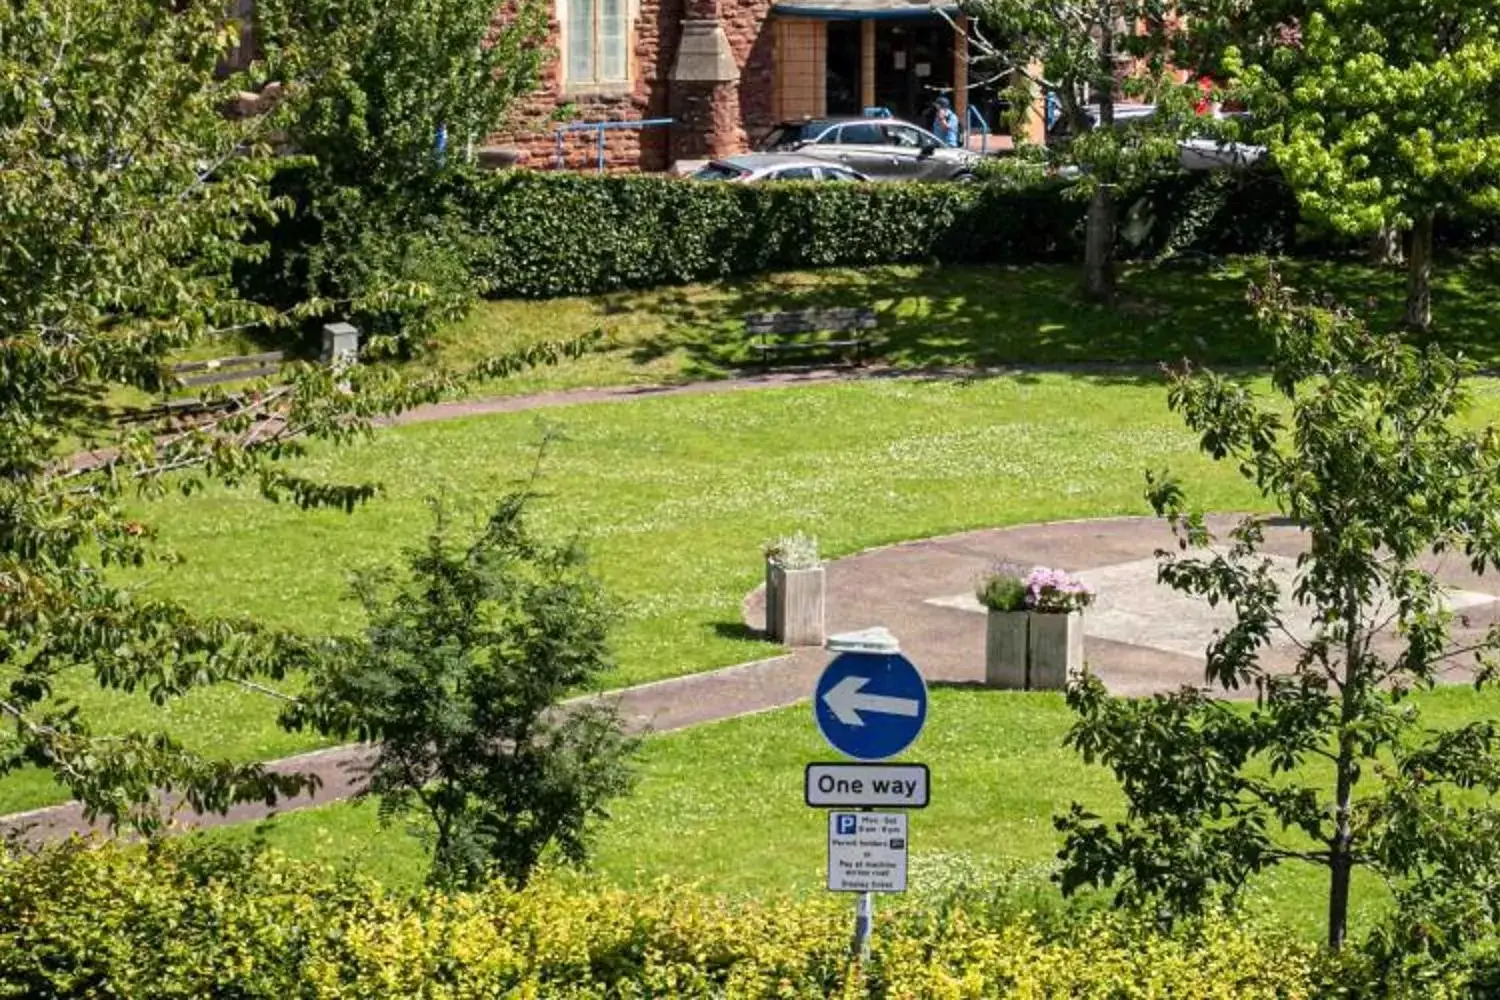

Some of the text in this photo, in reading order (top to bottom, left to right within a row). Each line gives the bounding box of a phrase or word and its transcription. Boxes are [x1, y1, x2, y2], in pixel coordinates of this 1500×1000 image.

[818, 775, 917, 798] One way
[840, 860, 852, 869] Pay
